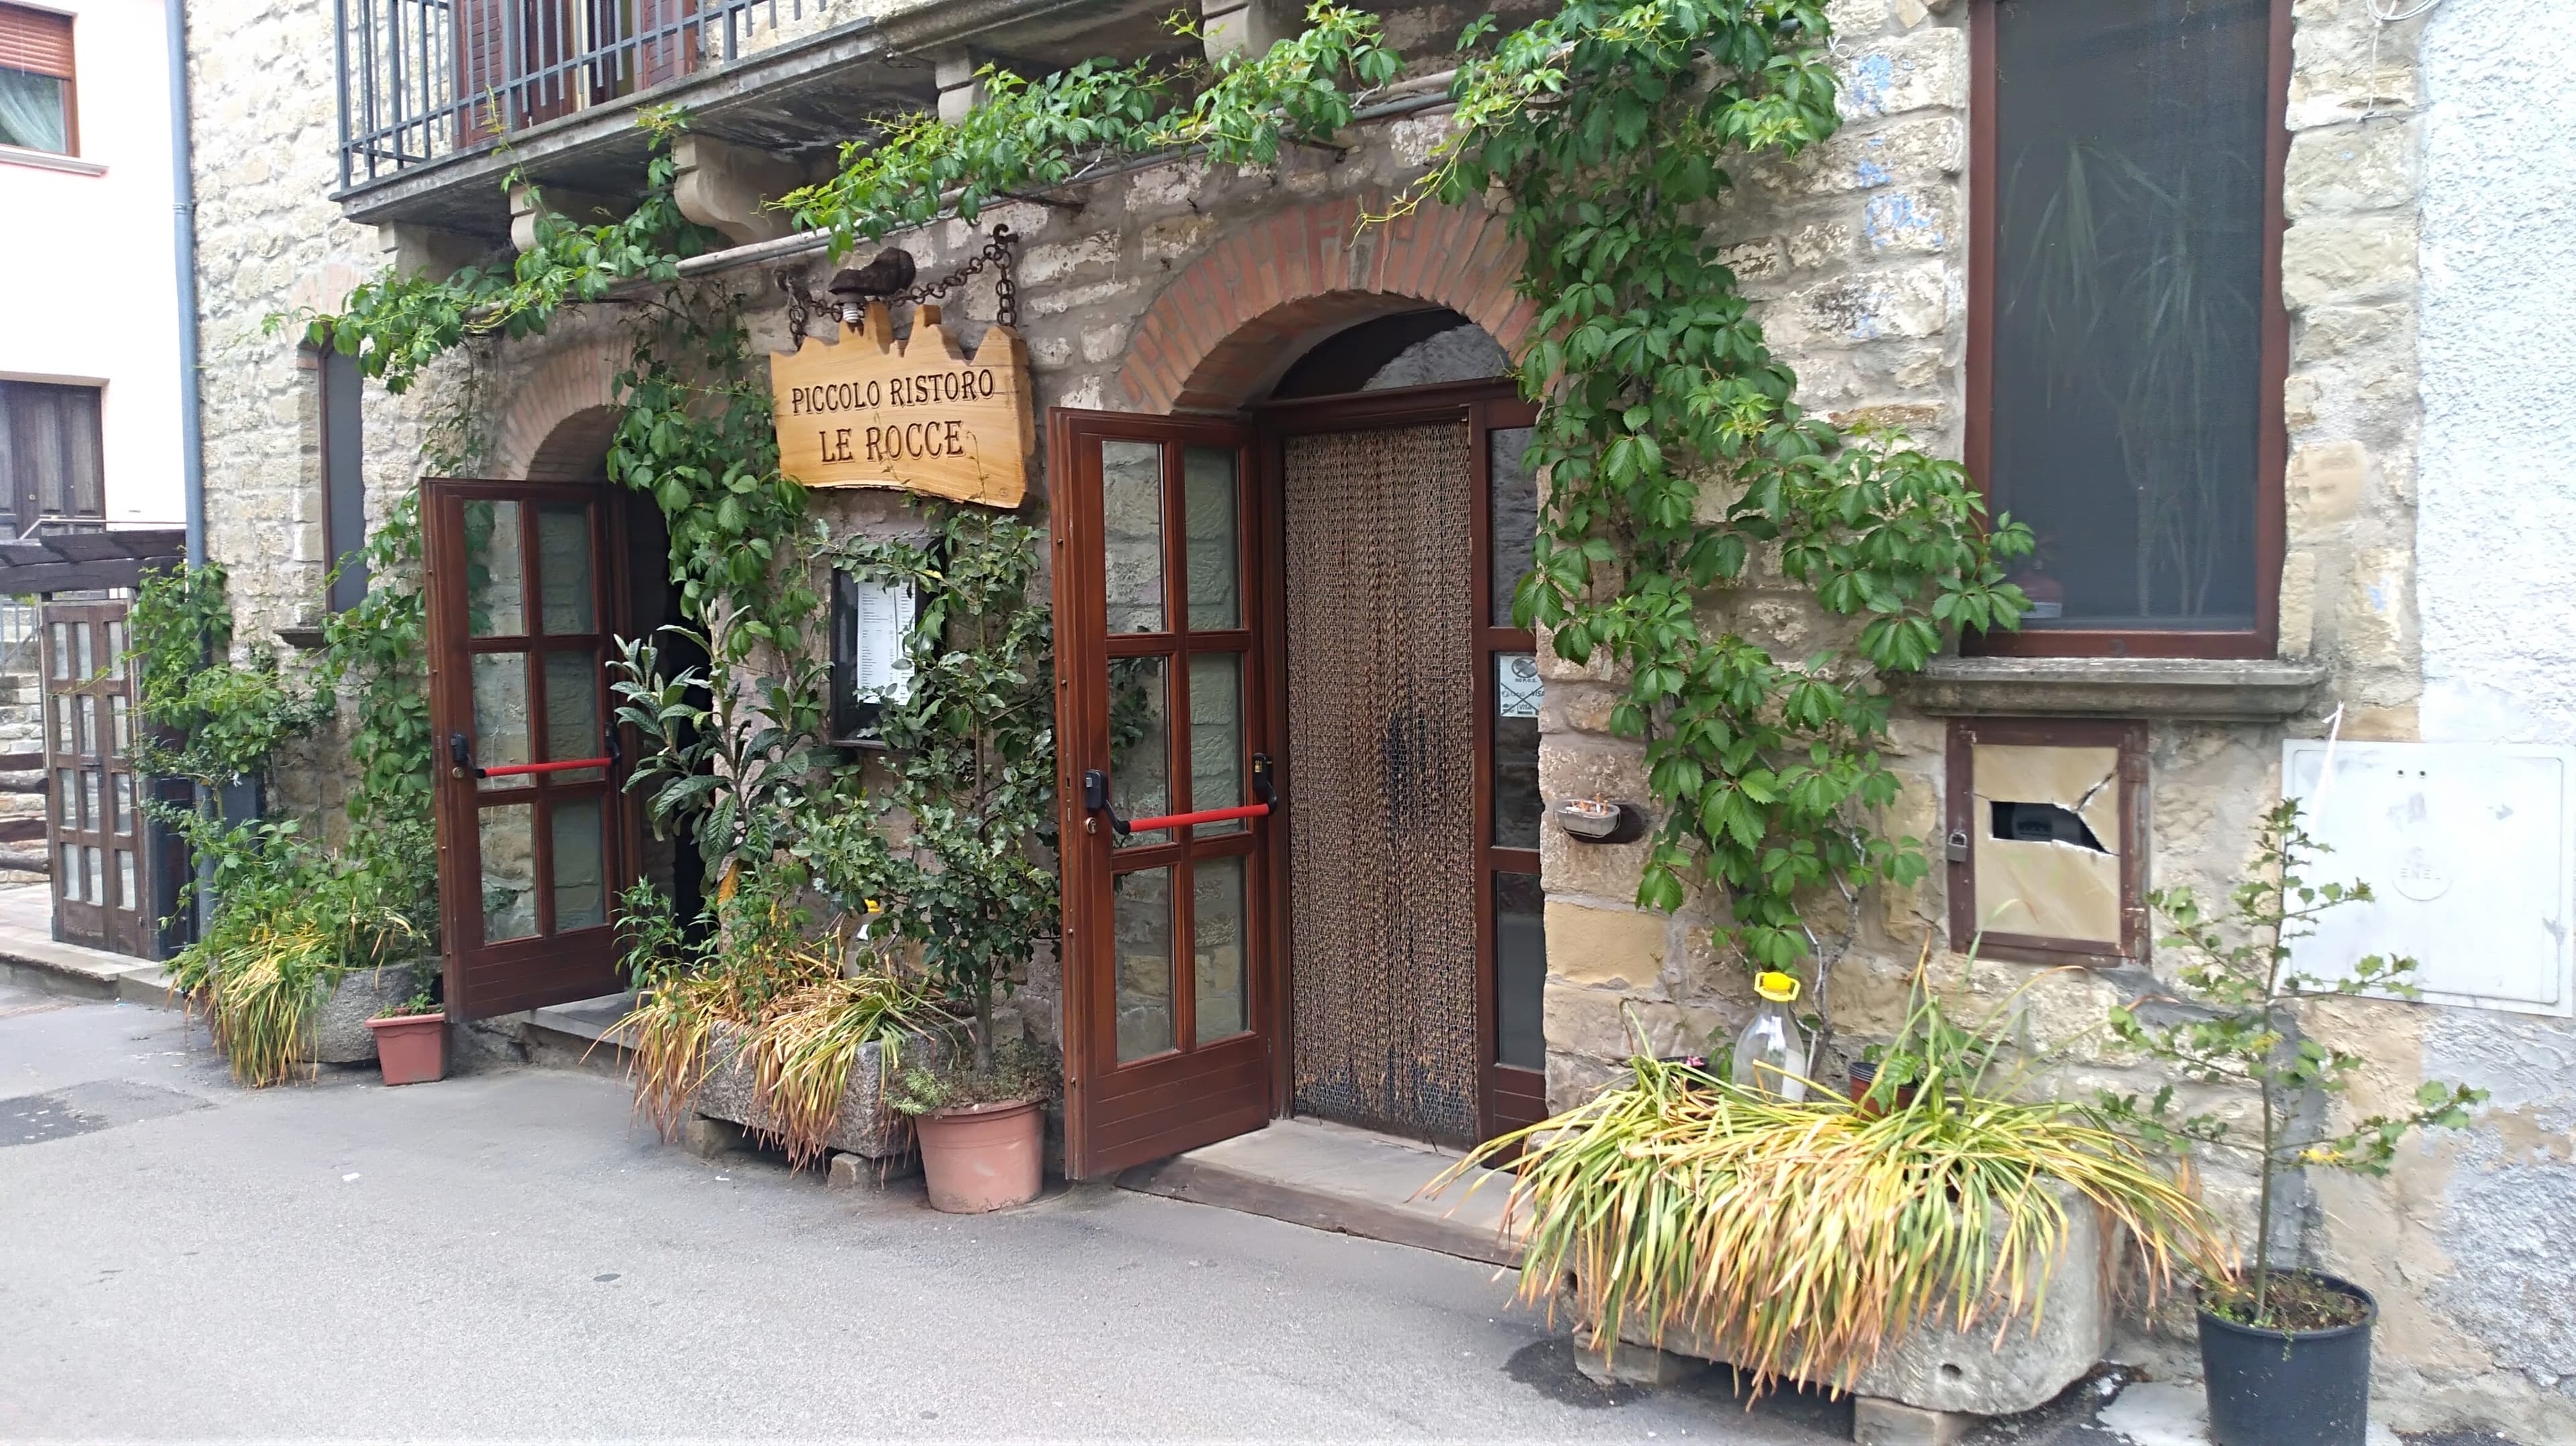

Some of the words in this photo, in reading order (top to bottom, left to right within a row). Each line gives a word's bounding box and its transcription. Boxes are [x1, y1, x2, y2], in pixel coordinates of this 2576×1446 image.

[792, 380, 881, 414] PICCOLO
[890, 369, 994, 407] RISTORO
[819, 428, 854, 463] LE
[865, 420, 965, 462] ROCCE
